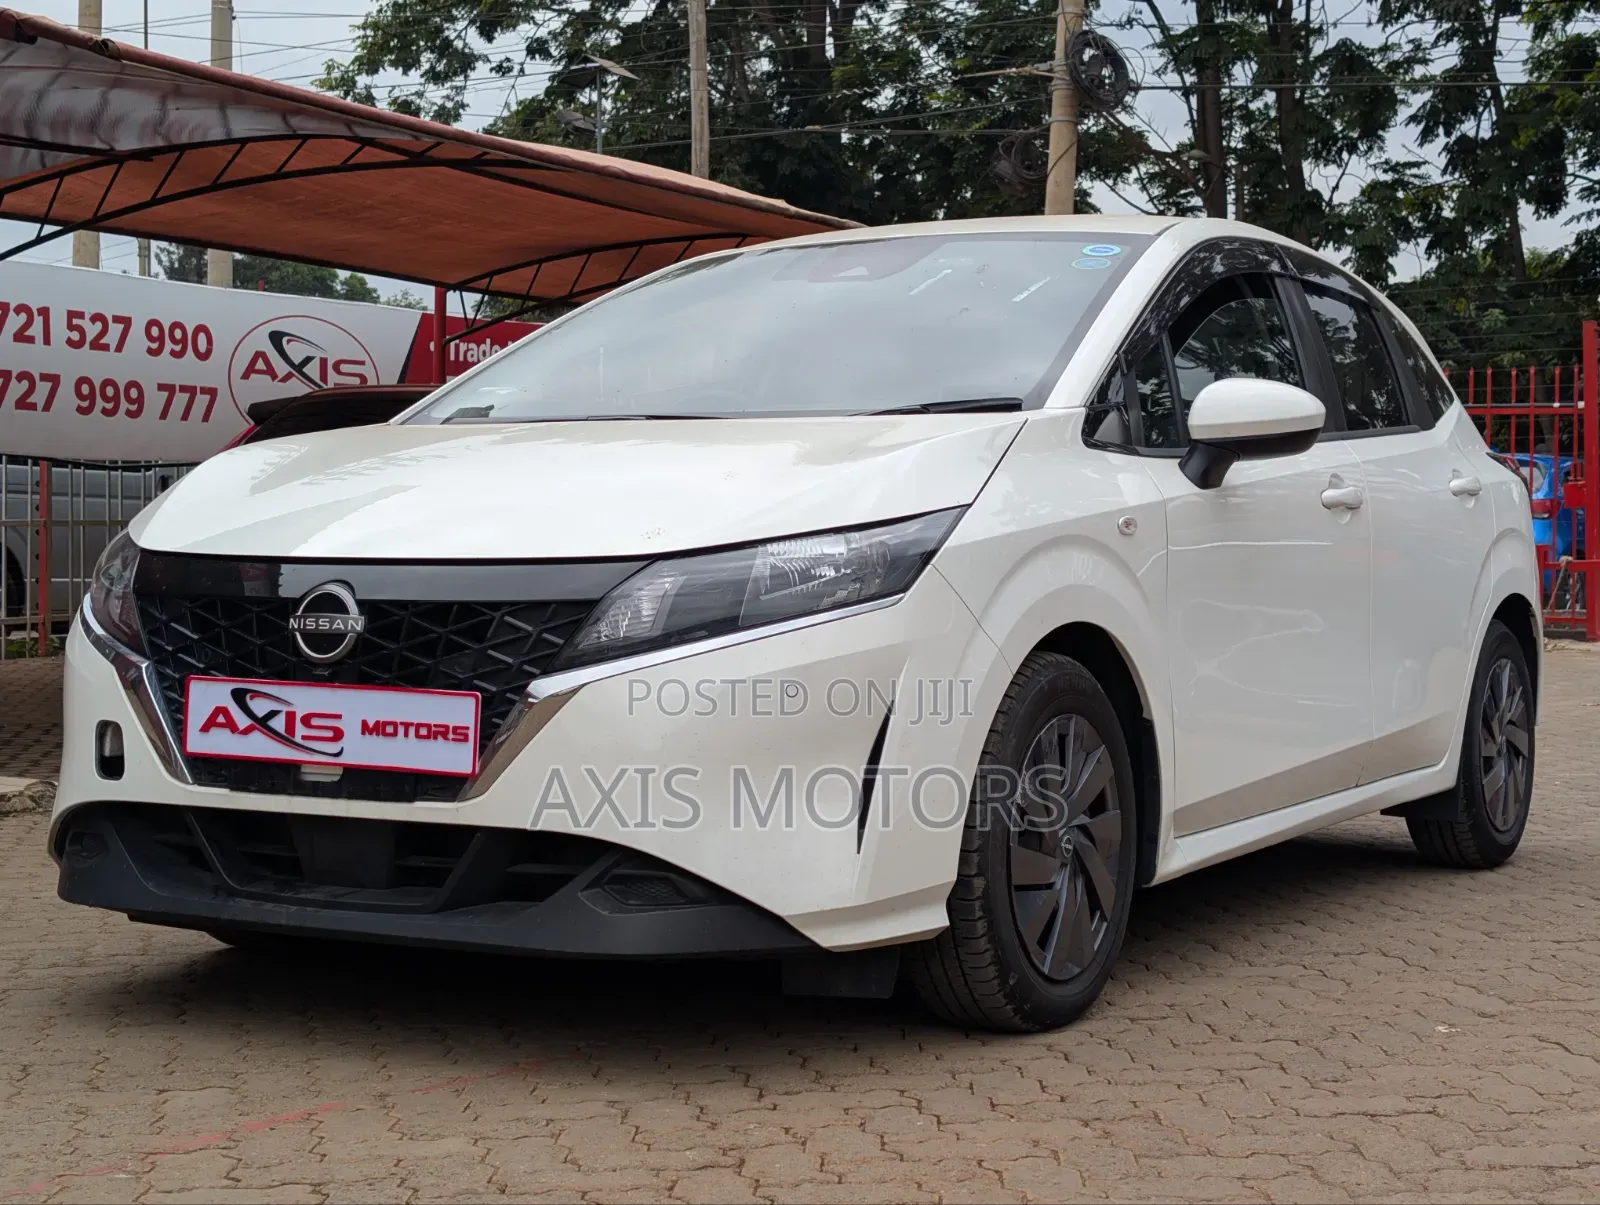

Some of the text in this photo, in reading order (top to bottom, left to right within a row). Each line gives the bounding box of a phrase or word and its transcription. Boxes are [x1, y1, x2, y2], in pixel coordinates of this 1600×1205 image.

[65, 309, 132, 353] 527
[145, 318, 213, 362] 990
[240, 330, 369, 391] AXIS
[74, 376, 145, 419] 999
[157, 383, 218, 423] 777
[289, 617, 361, 631] NISSAN
[199, 687, 470, 758] AXIS MOTORS
